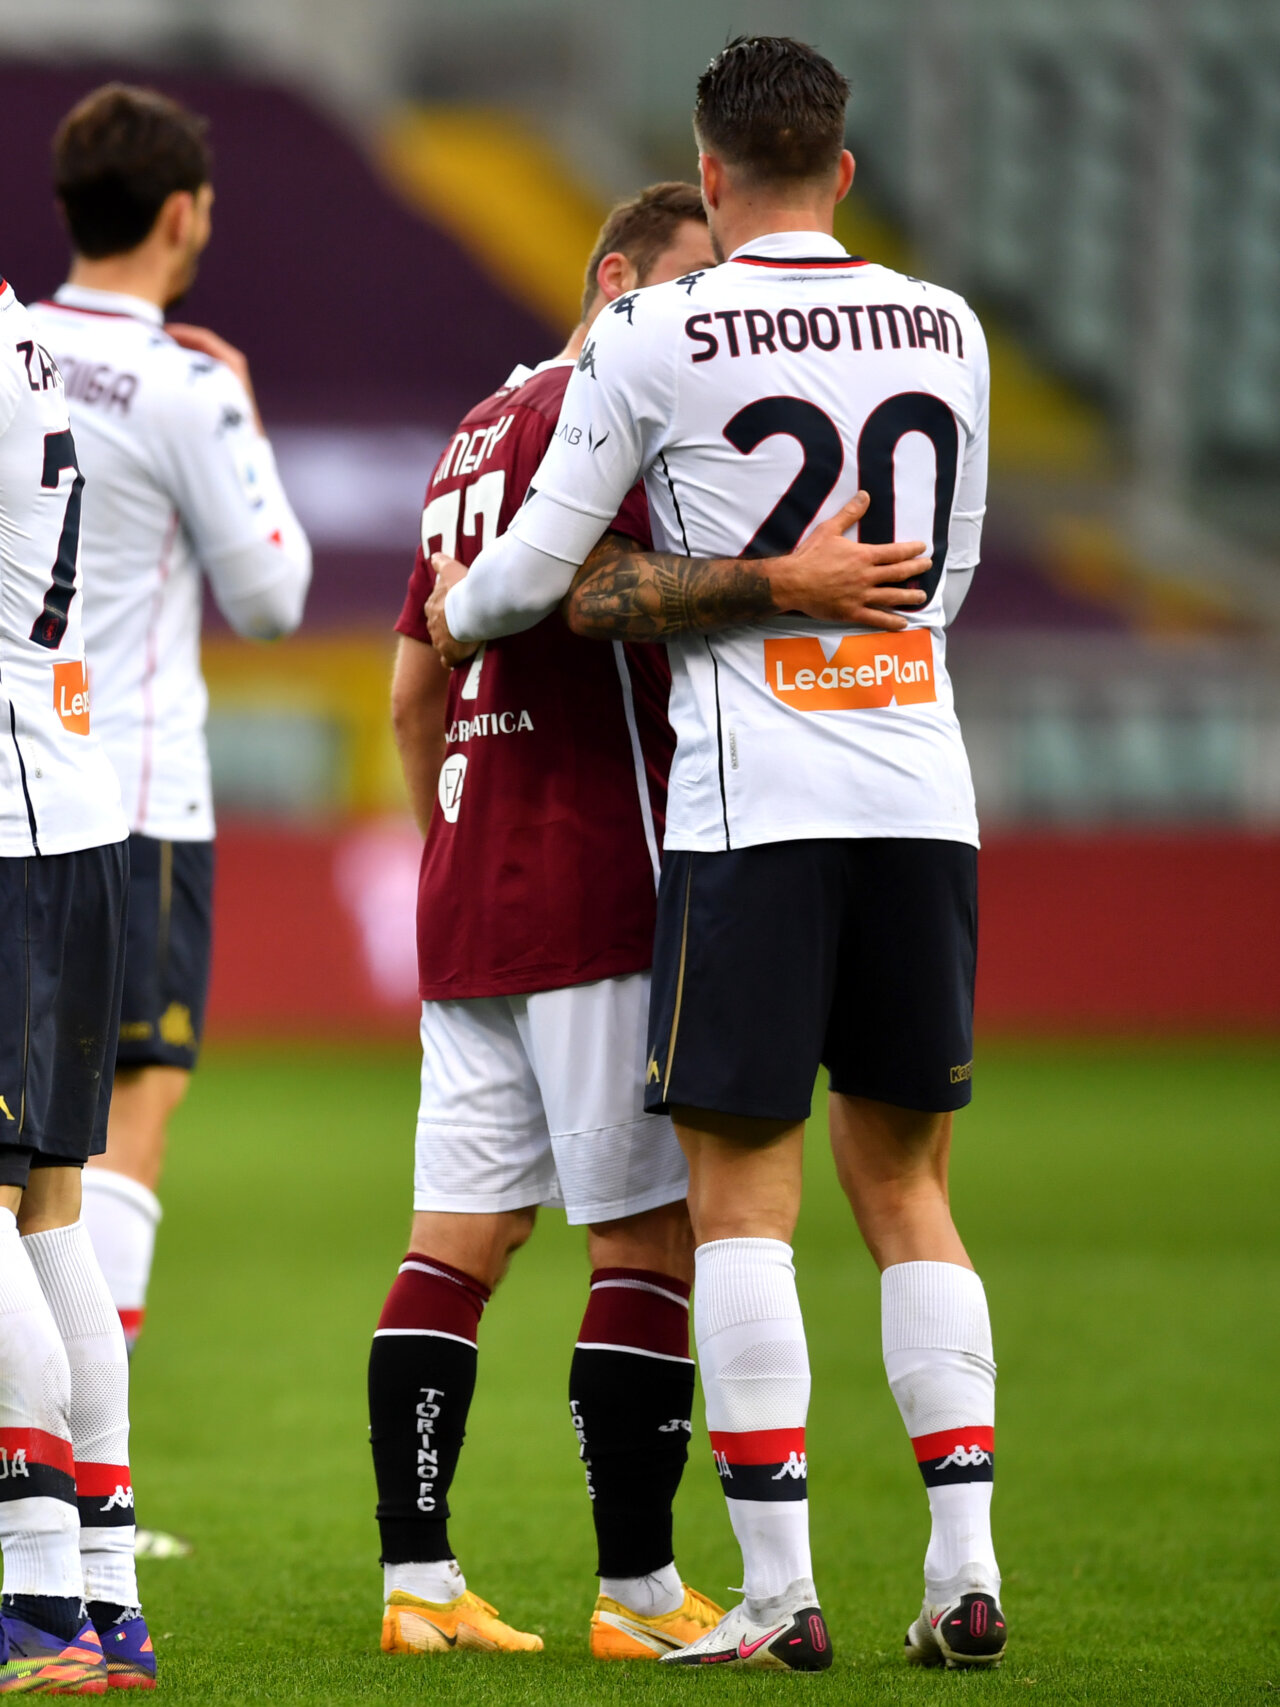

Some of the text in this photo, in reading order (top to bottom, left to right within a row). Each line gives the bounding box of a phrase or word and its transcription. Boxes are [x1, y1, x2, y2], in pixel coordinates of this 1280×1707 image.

[683, 304, 965, 364] STROOTMAN
[28, 428, 86, 651] 7
[421, 470, 506, 701] 77
[722, 391, 959, 613] 20
[776, 654, 930, 692] LeasePlan
